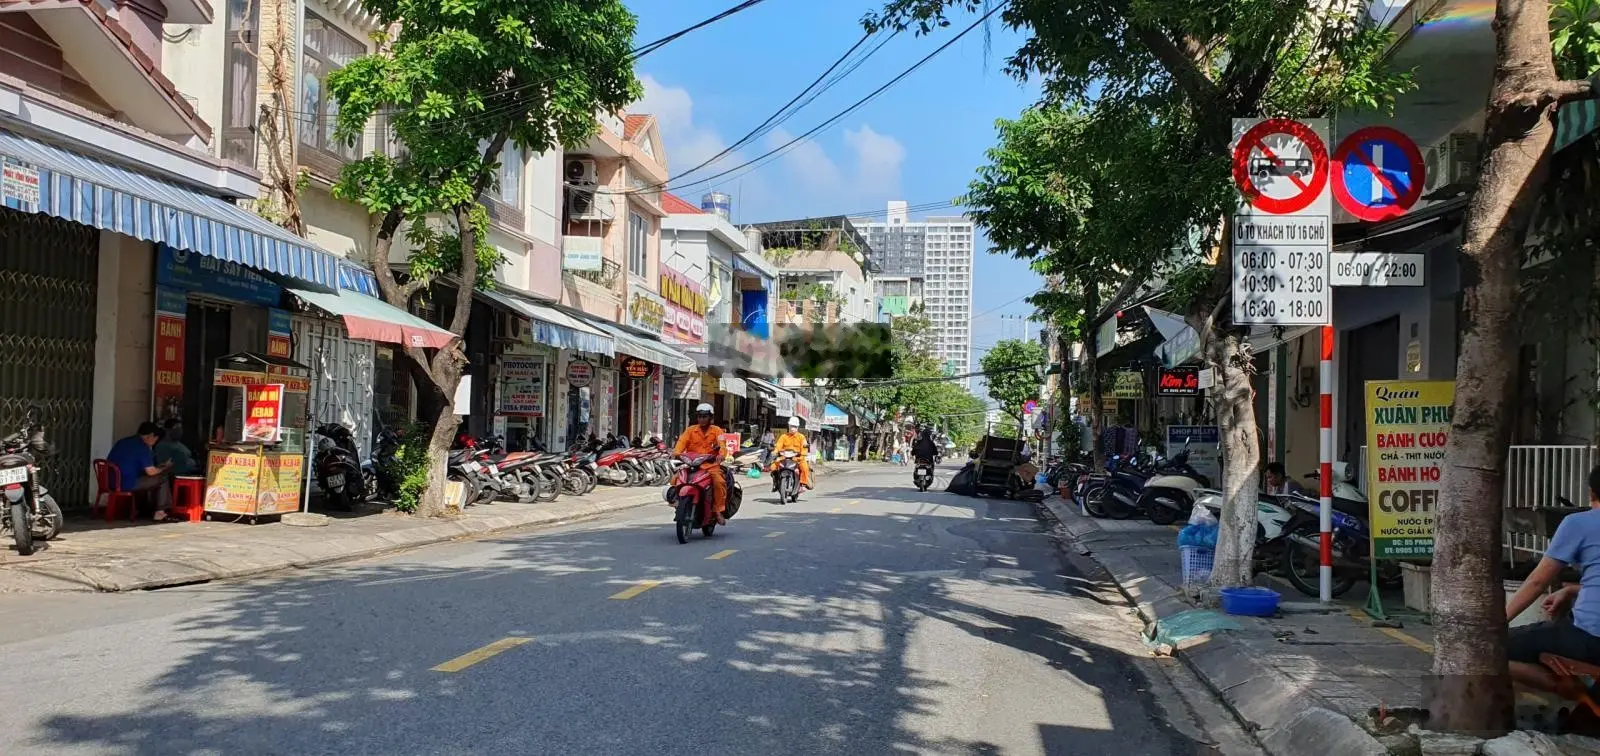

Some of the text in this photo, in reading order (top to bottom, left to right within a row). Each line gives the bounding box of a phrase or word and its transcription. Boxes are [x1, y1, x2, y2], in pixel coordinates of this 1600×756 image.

[1245, 222, 1255, 240] TÔ
[1257, 222, 1284, 240] KHÁCH
[1286, 221, 1297, 240] TỪ
[1298, 225, 1307, 240] 16
[1241, 251, 1276, 269] 06:00
[1288, 252, 1323, 270] 07:30
[1337, 262, 1370, 277] 06:00
[1383, 262, 1417, 278] 22:00
[1241, 275, 1276, 293] 10:30
[1288, 275, 1323, 293] 12:30
[1241, 300, 1276, 318] 16:30
[1288, 300, 1323, 318] 18:00
[160, 321, 182, 337] BÁNH
[156, 370, 182, 385] KEBAB
[1160, 374, 1183, 387] Kim
[247, 389, 267, 401] BÁNH
[1375, 386, 1419, 402] Quán
[251, 406, 274, 418] KEBAB
[1374, 403, 1417, 425] XUÂN
[1376, 427, 1449, 449] BÁNH CUỐ
[1380, 450, 1399, 461] CHẢ
[1378, 464, 1417, 483] BÁNH
